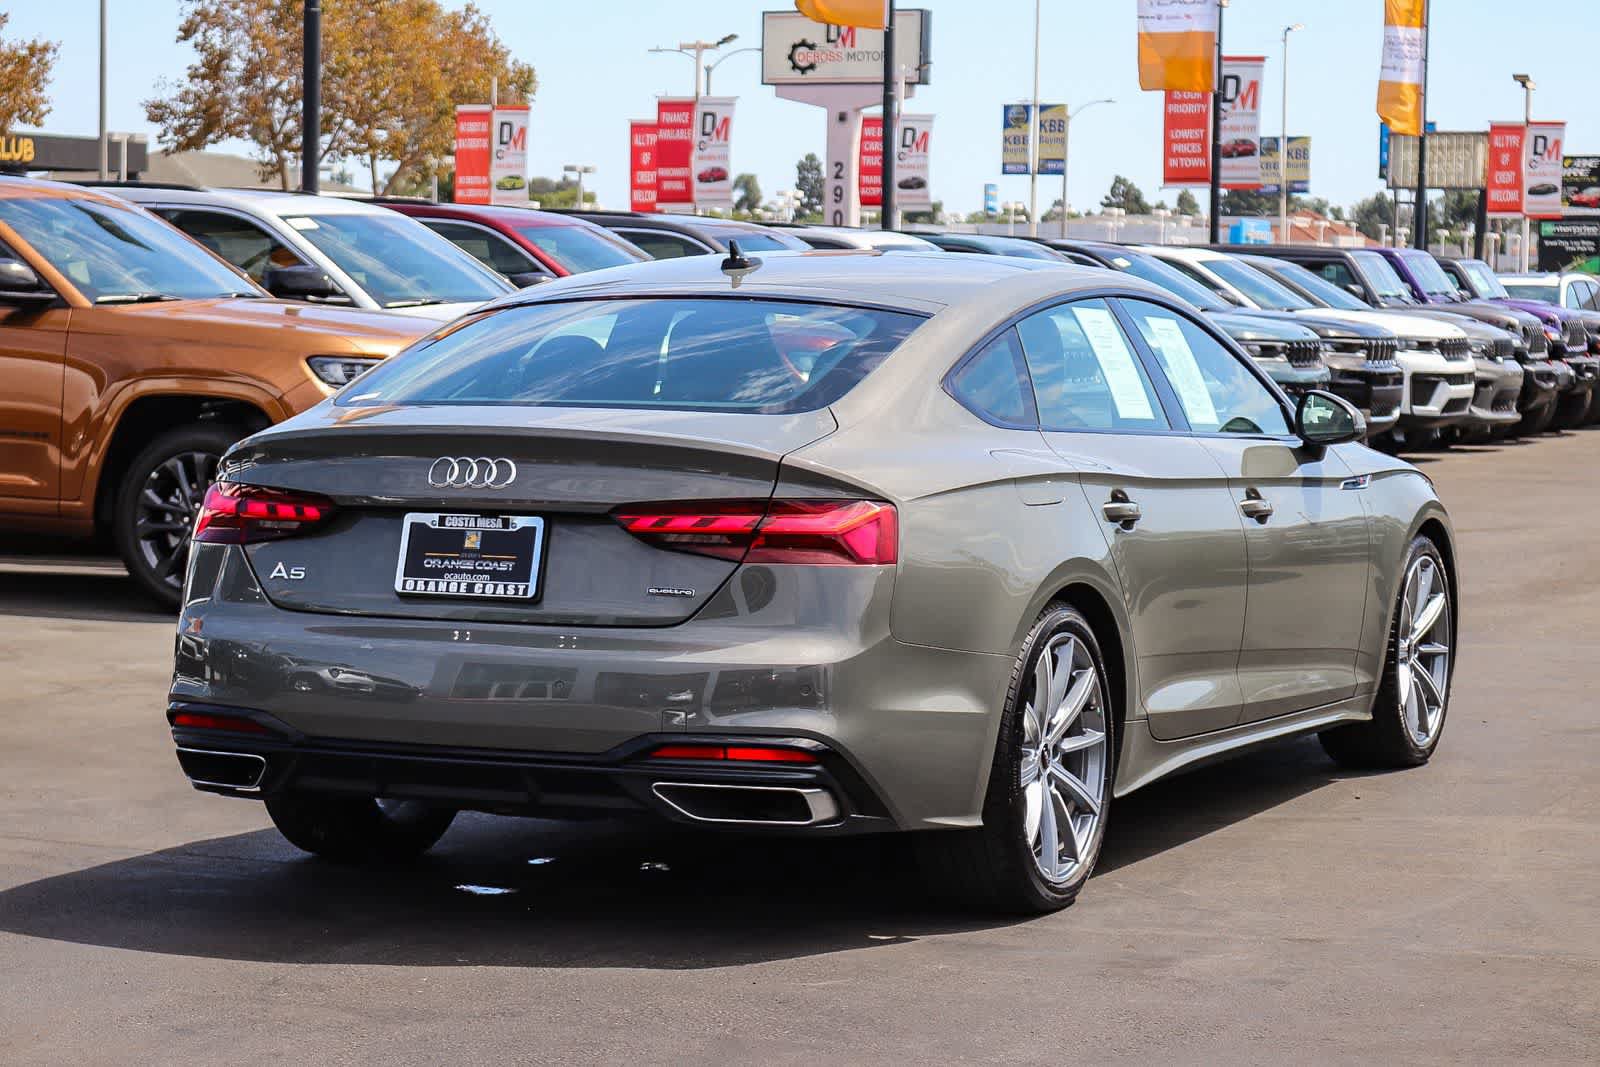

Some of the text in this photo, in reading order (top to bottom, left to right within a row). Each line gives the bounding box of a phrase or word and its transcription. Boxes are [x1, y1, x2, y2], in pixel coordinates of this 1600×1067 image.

[1168, 104, 1207, 114] PRIORITY
[662, 112, 689, 123] FINANCE
[1040, 119, 1065, 133] KBB
[646, 133, 657, 146] TYP
[659, 129, 692, 140] AVAILABLE
[1171, 128, 1205, 139] LOWEST
[1494, 135, 1520, 148] ALL TYPE
[0, 136, 34, 161] LUB
[1173, 143, 1202, 153] PRICES
[863, 155, 882, 167] TRUC
[1169, 157, 1207, 168] IN TOWN
[633, 190, 657, 202] WELCOM
[1491, 190, 1520, 202] WELCOME
[445, 516, 502, 529] COSTA MESA
[269, 561, 306, 580] A5
[424, 558, 515, 571] ORANGE COAST
[444, 572, 490, 582] ocauto.com
[405, 580, 526, 595] ORANGE COAST
